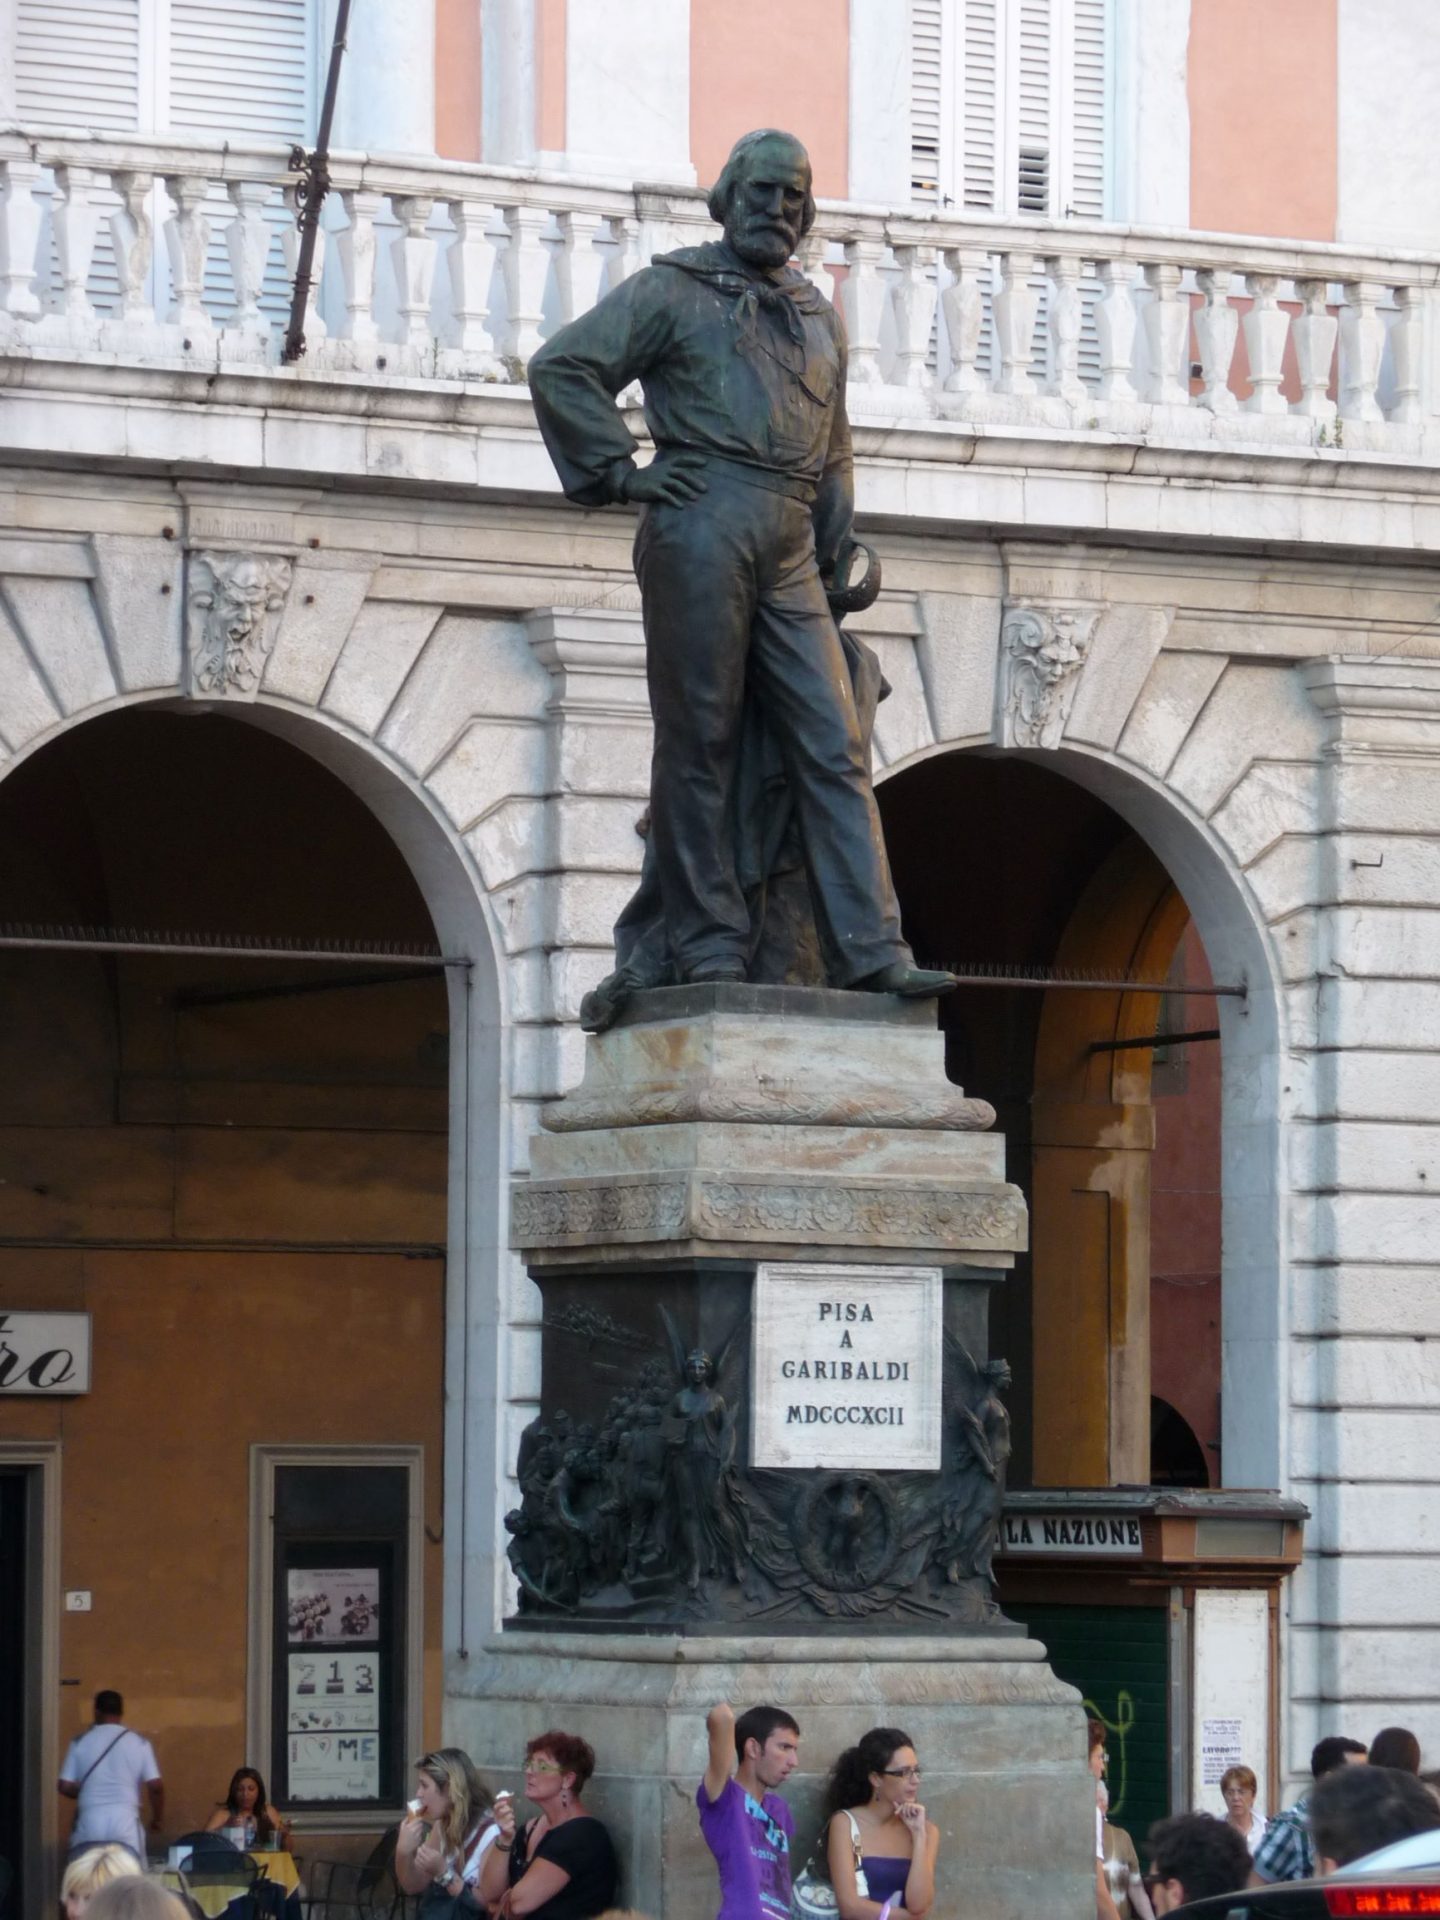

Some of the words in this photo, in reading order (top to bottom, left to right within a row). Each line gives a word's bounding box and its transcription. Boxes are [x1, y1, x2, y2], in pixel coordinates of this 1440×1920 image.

[818, 1302, 874, 1322] PISA
[839, 1329, 853, 1348] A
[781, 1360, 910, 1381] GARIBALDI
[786, 1404, 905, 1426] MDCCCXCII
[1006, 1518, 1033, 1544] LA
[1043, 1519, 1140, 1545] NAZIONE
[72, 1594, 84, 1608] 5
[327, 1660, 344, 1683] 1
[355, 1663, 373, 1688] 3
[338, 1738, 376, 1761] ME
